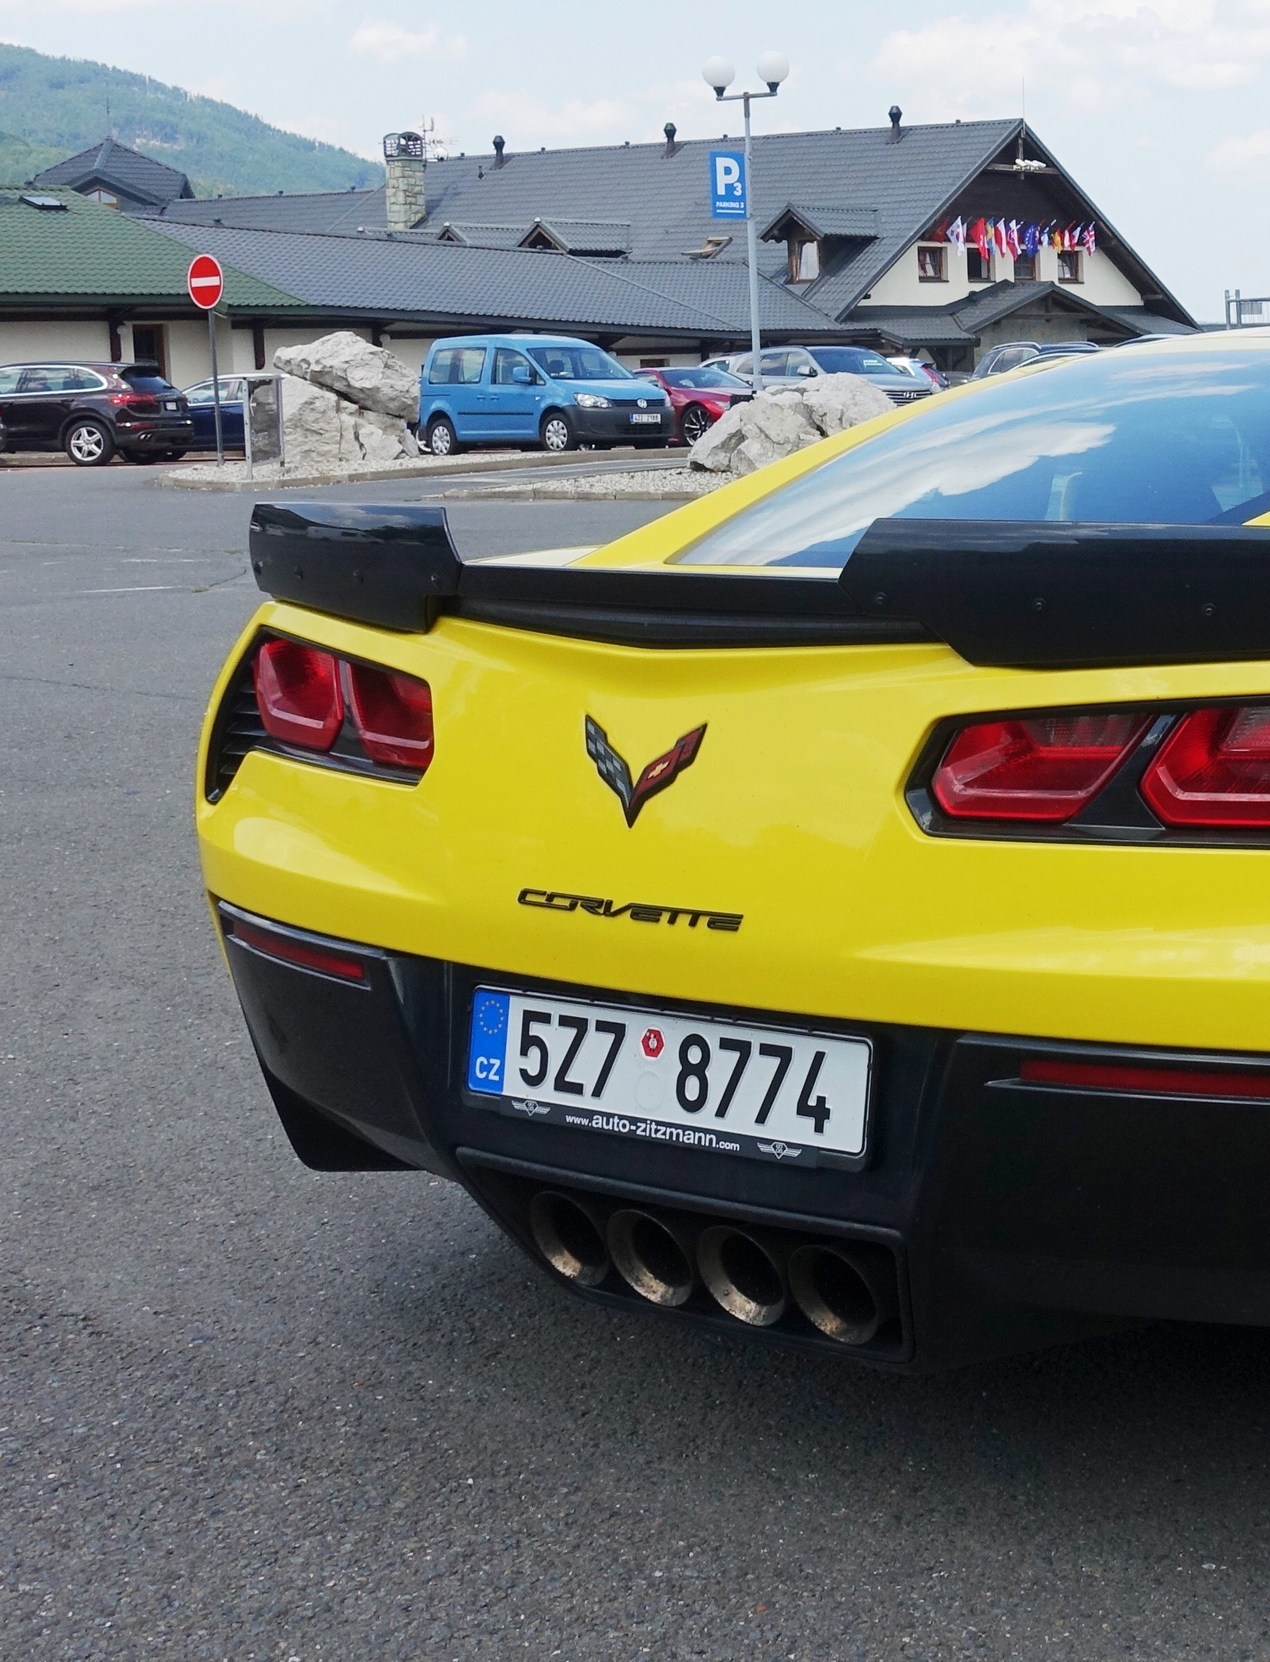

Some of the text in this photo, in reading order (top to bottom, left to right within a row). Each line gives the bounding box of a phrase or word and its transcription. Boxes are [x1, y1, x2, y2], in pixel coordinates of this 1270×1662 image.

[517, 888, 744, 931] CORVETTE
[475, 1056, 501, 1081] CZ
[519, 1009, 831, 1134] 5Z7 8774
[565, 1113, 740, 1151] www.auto-zitzmann.com
